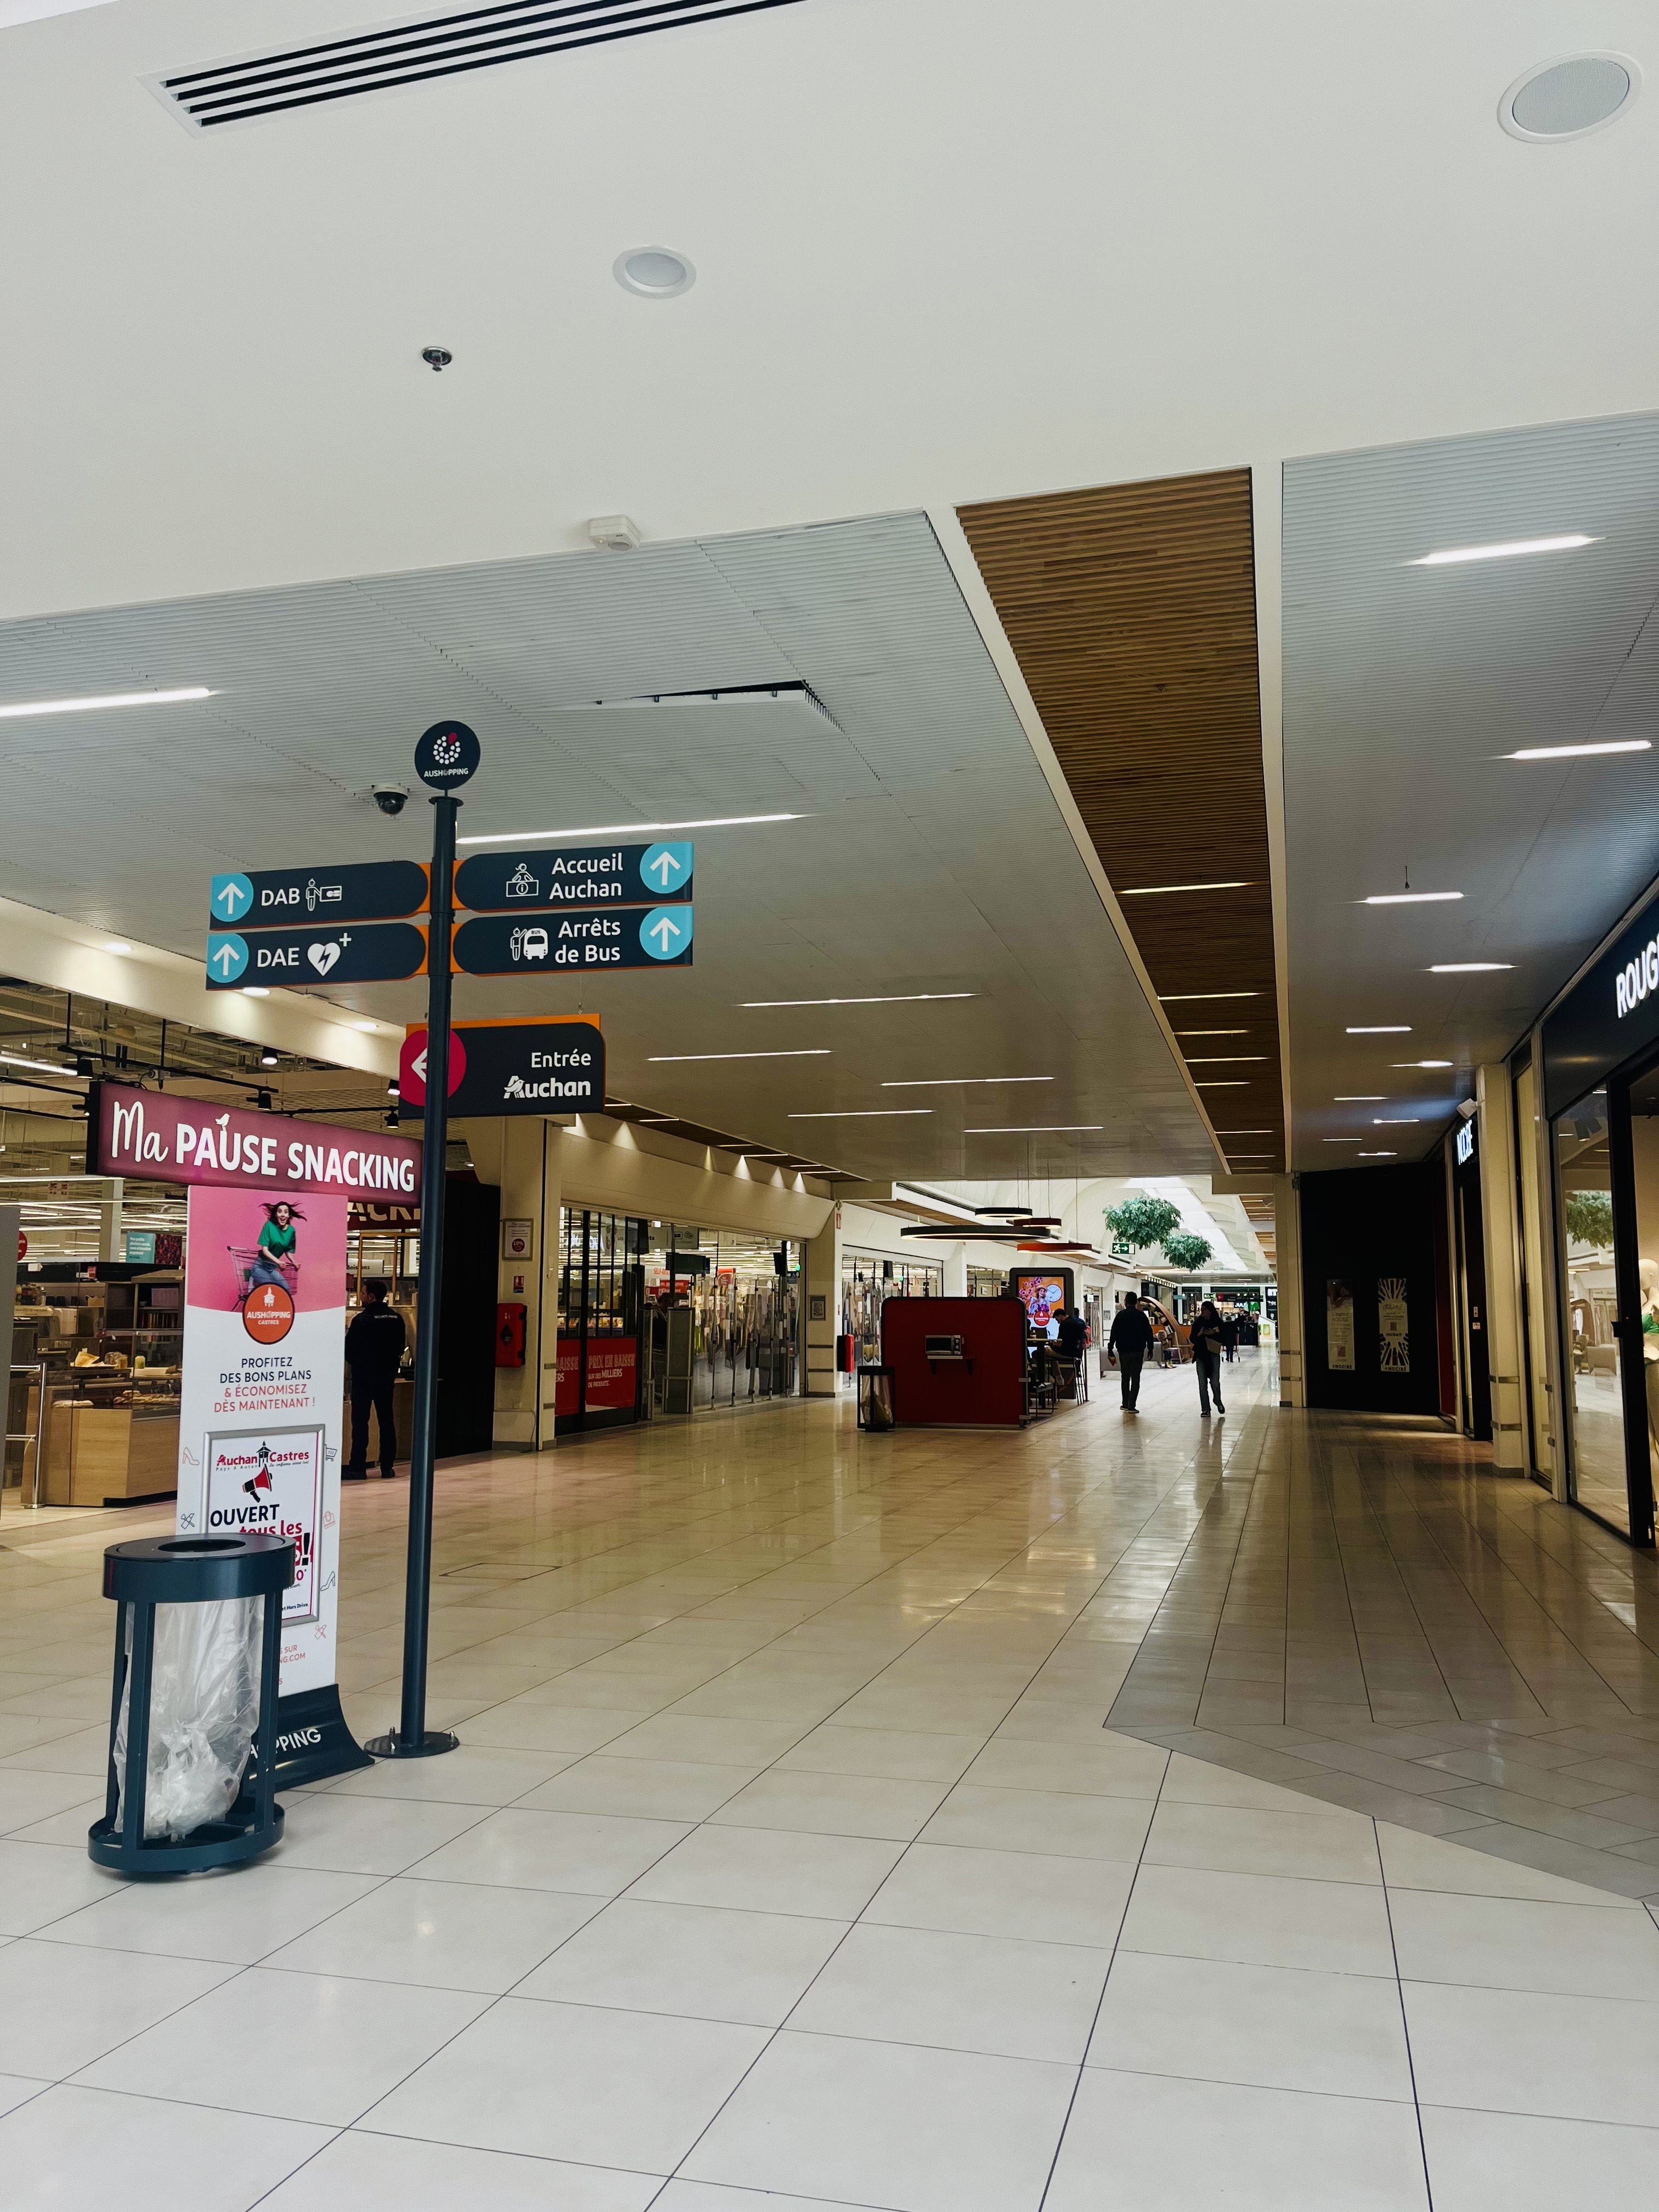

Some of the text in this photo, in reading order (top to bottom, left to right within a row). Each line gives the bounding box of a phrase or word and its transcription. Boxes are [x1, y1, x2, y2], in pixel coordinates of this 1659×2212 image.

[551, 852, 623, 875] Accueil
[261, 888, 300, 906] DAB
[549, 879, 622, 900] Auchan
[558, 917, 621, 939] Arrêts
[257, 947, 300, 968] DAE
[555, 944, 620, 964] de Bus
[1616, 930, 1659, 1018] ROUG
[531, 1048, 591, 1068] Entrée
[503, 1075, 591, 1099] Auchan
[112, 1101, 415, 1192] Ma PAUSE SNACKING
[241, 1357, 293, 1368] PROFITEZ
[220, 1370, 312, 1384] DES BONS PLANS
[224, 1384, 307, 1397] & ÉCONOMISEZ
[214, 1397, 315, 1413] DÈS MAINTENANT !
[216, 1451, 309, 1466] Auchan Castres
[210, 1504, 280, 1527] OUVERT
[280, 1520, 302, 1536] les
[284, 1645, 297, 1654] SUR
